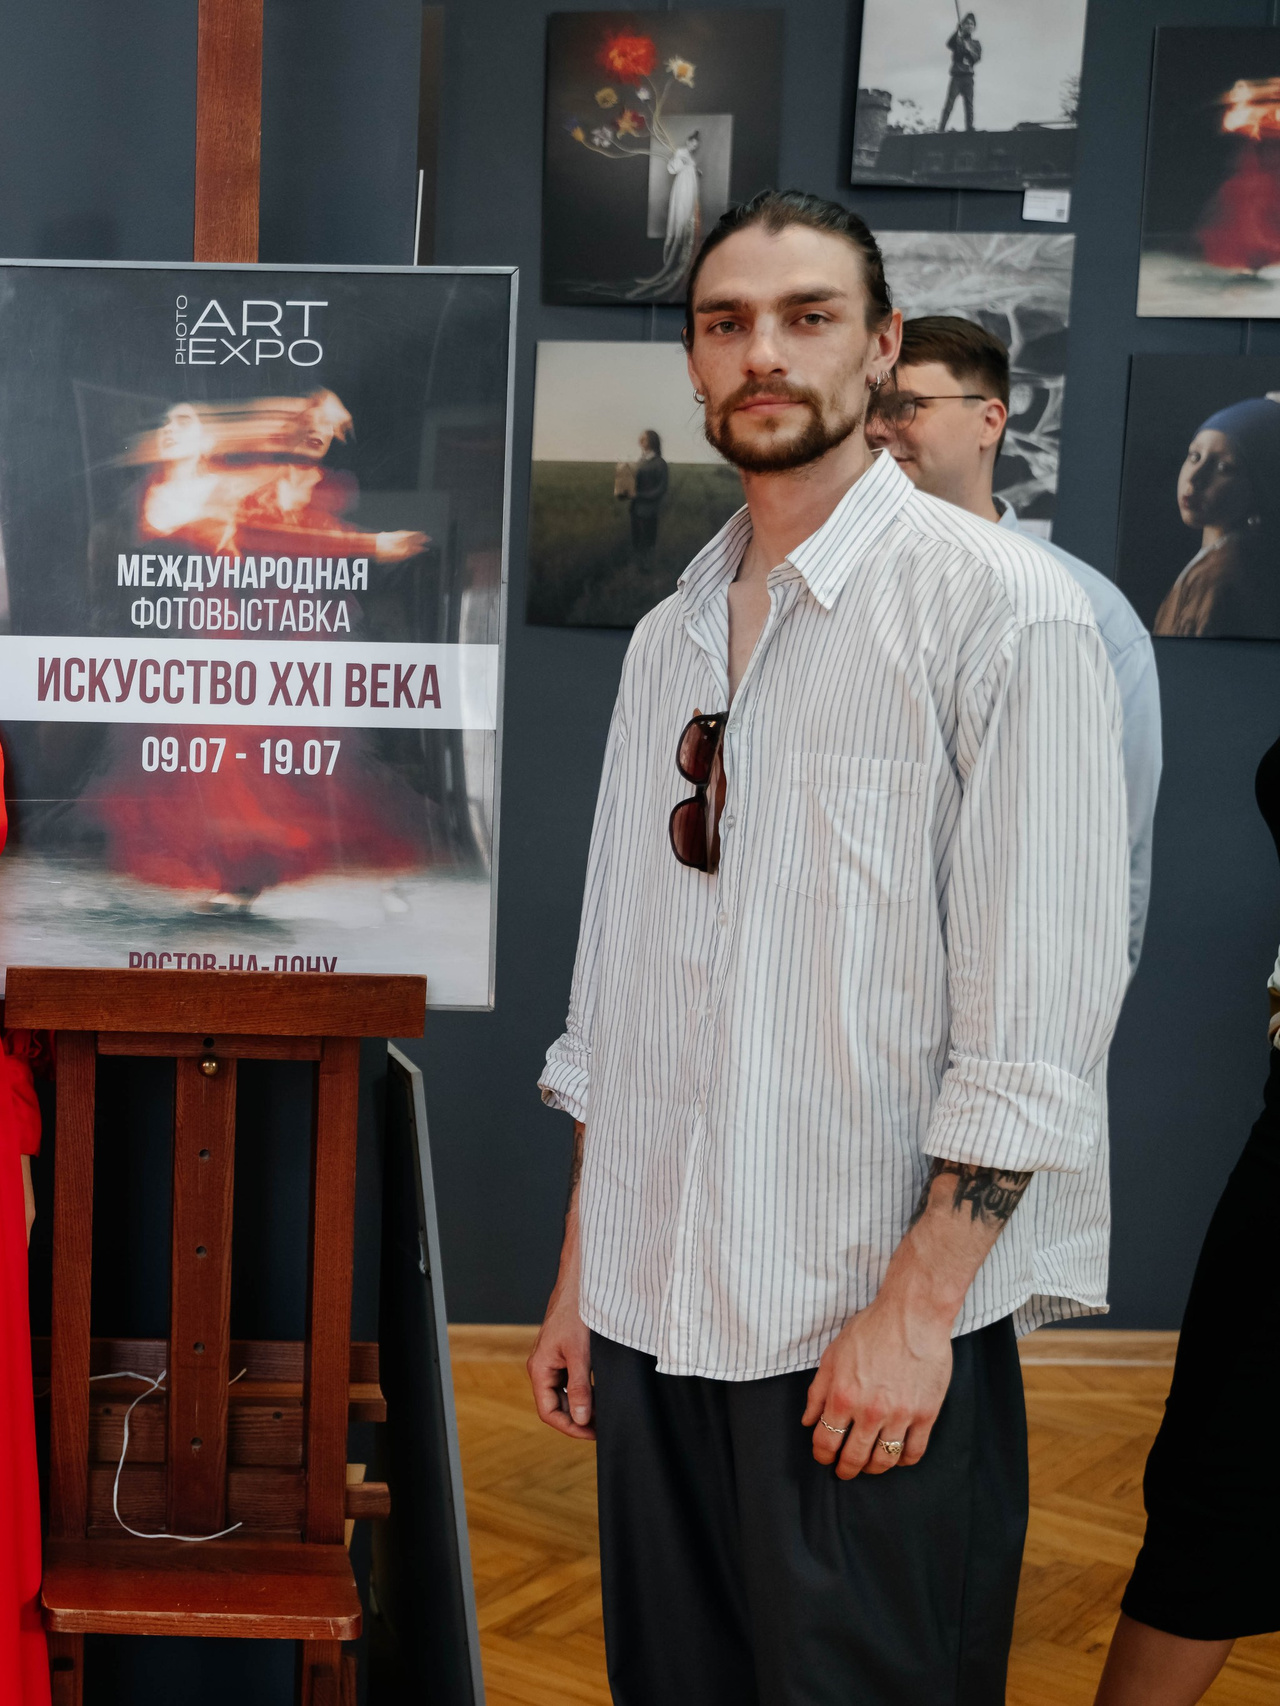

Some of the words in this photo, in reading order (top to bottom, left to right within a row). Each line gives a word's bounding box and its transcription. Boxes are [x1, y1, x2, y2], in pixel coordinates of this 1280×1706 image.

[175, 295, 188, 365] PHOTO
[189, 299, 328, 337] ART
[188, 338, 323, 367] EXPO
[117, 554, 369, 594] МЕЖДУНАРОДНАЯ
[131, 596, 351, 633] ФОТОВЫСТАВКА
[37, 657, 257, 706] ИСКУССТВО
[268, 661, 332, 708] XXI
[344, 662, 442, 710] ВЕКА
[141, 736, 226, 774] 09.07
[260, 738, 341, 776] 19.07
